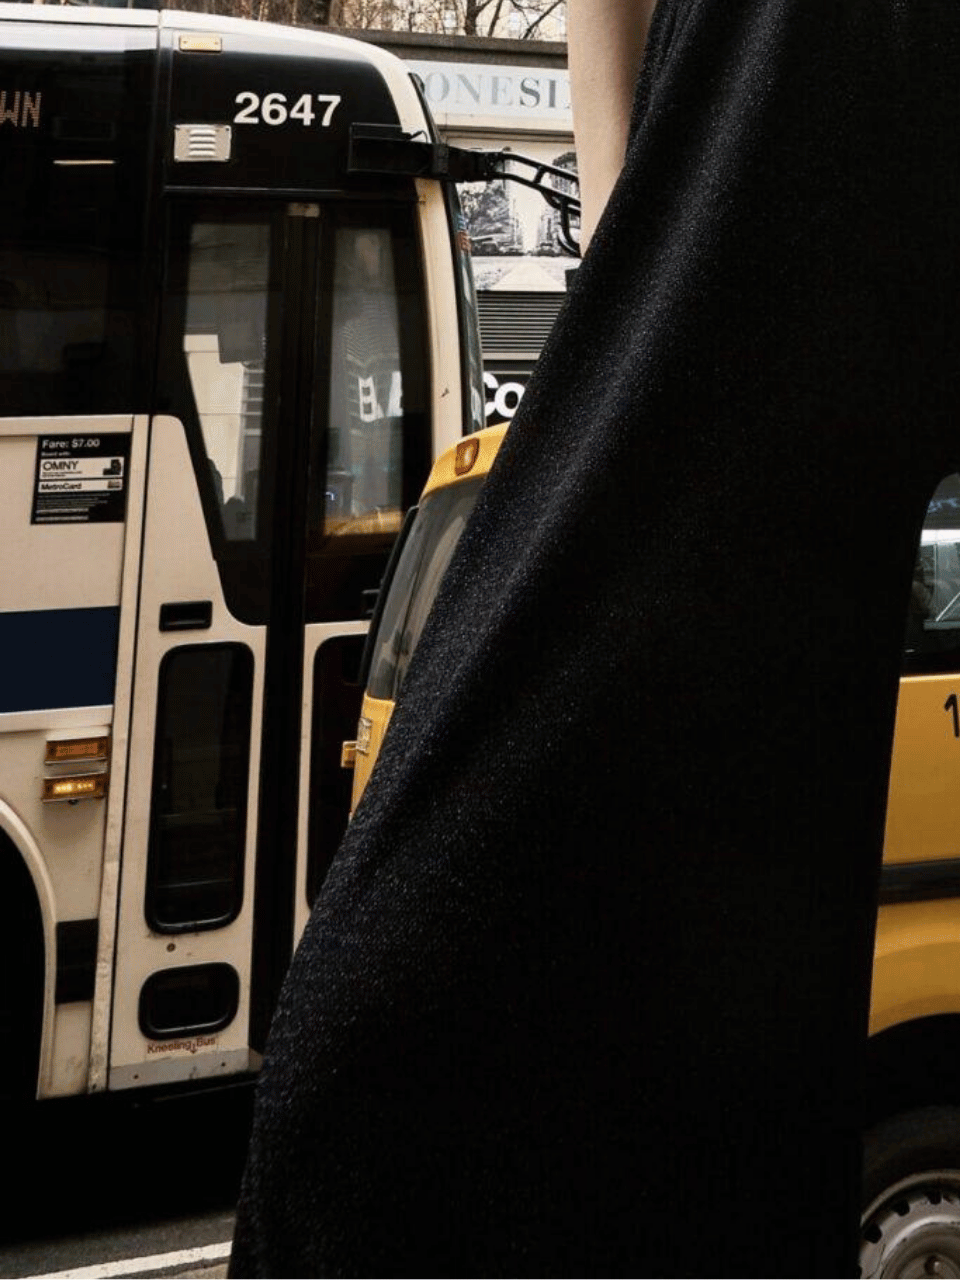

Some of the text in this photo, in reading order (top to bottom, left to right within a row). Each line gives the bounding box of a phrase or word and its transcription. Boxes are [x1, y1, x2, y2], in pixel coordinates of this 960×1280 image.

[425, 71, 572, 109] ONESI
[233, 91, 341, 127] 2647
[42, 438, 100, 449] Fare: $7.00
[43, 460, 79, 471] OMNY
[40, 482, 82, 490] MetroCard
[196, 1037, 216, 1047] Bus
